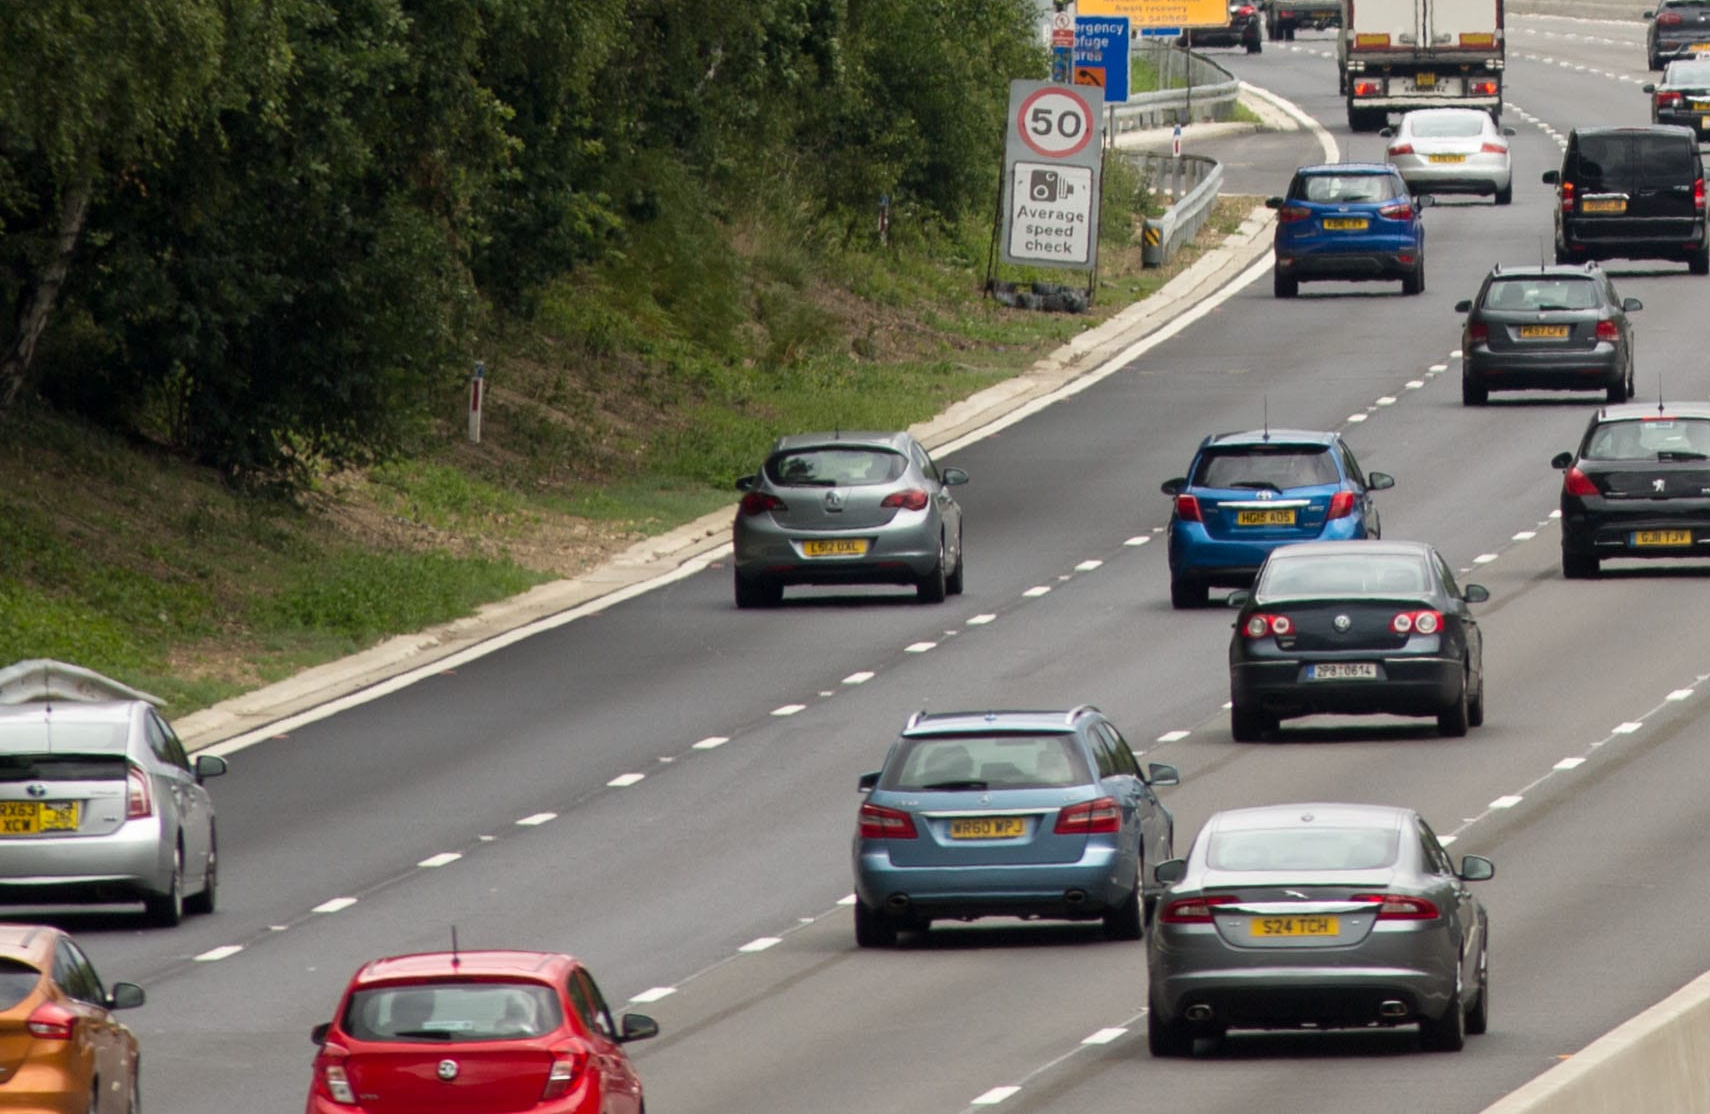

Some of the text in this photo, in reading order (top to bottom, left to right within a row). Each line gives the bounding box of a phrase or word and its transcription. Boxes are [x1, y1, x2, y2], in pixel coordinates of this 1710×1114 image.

[1074, 23, 1124, 36] ergency
[1073, 36, 1109, 48] efuge
[1031, 107, 1082, 138] 50
[1017, 205, 1085, 223] Average
[1025, 222, 1074, 237] speed
[1025, 238, 1073, 254] check
[0, 803, 36, 817] RX63
[3, 817, 31, 831] XCW
[954, 819, 1024, 834] WR60 WPJ
[1263, 918, 1328, 934] S24 TCH
